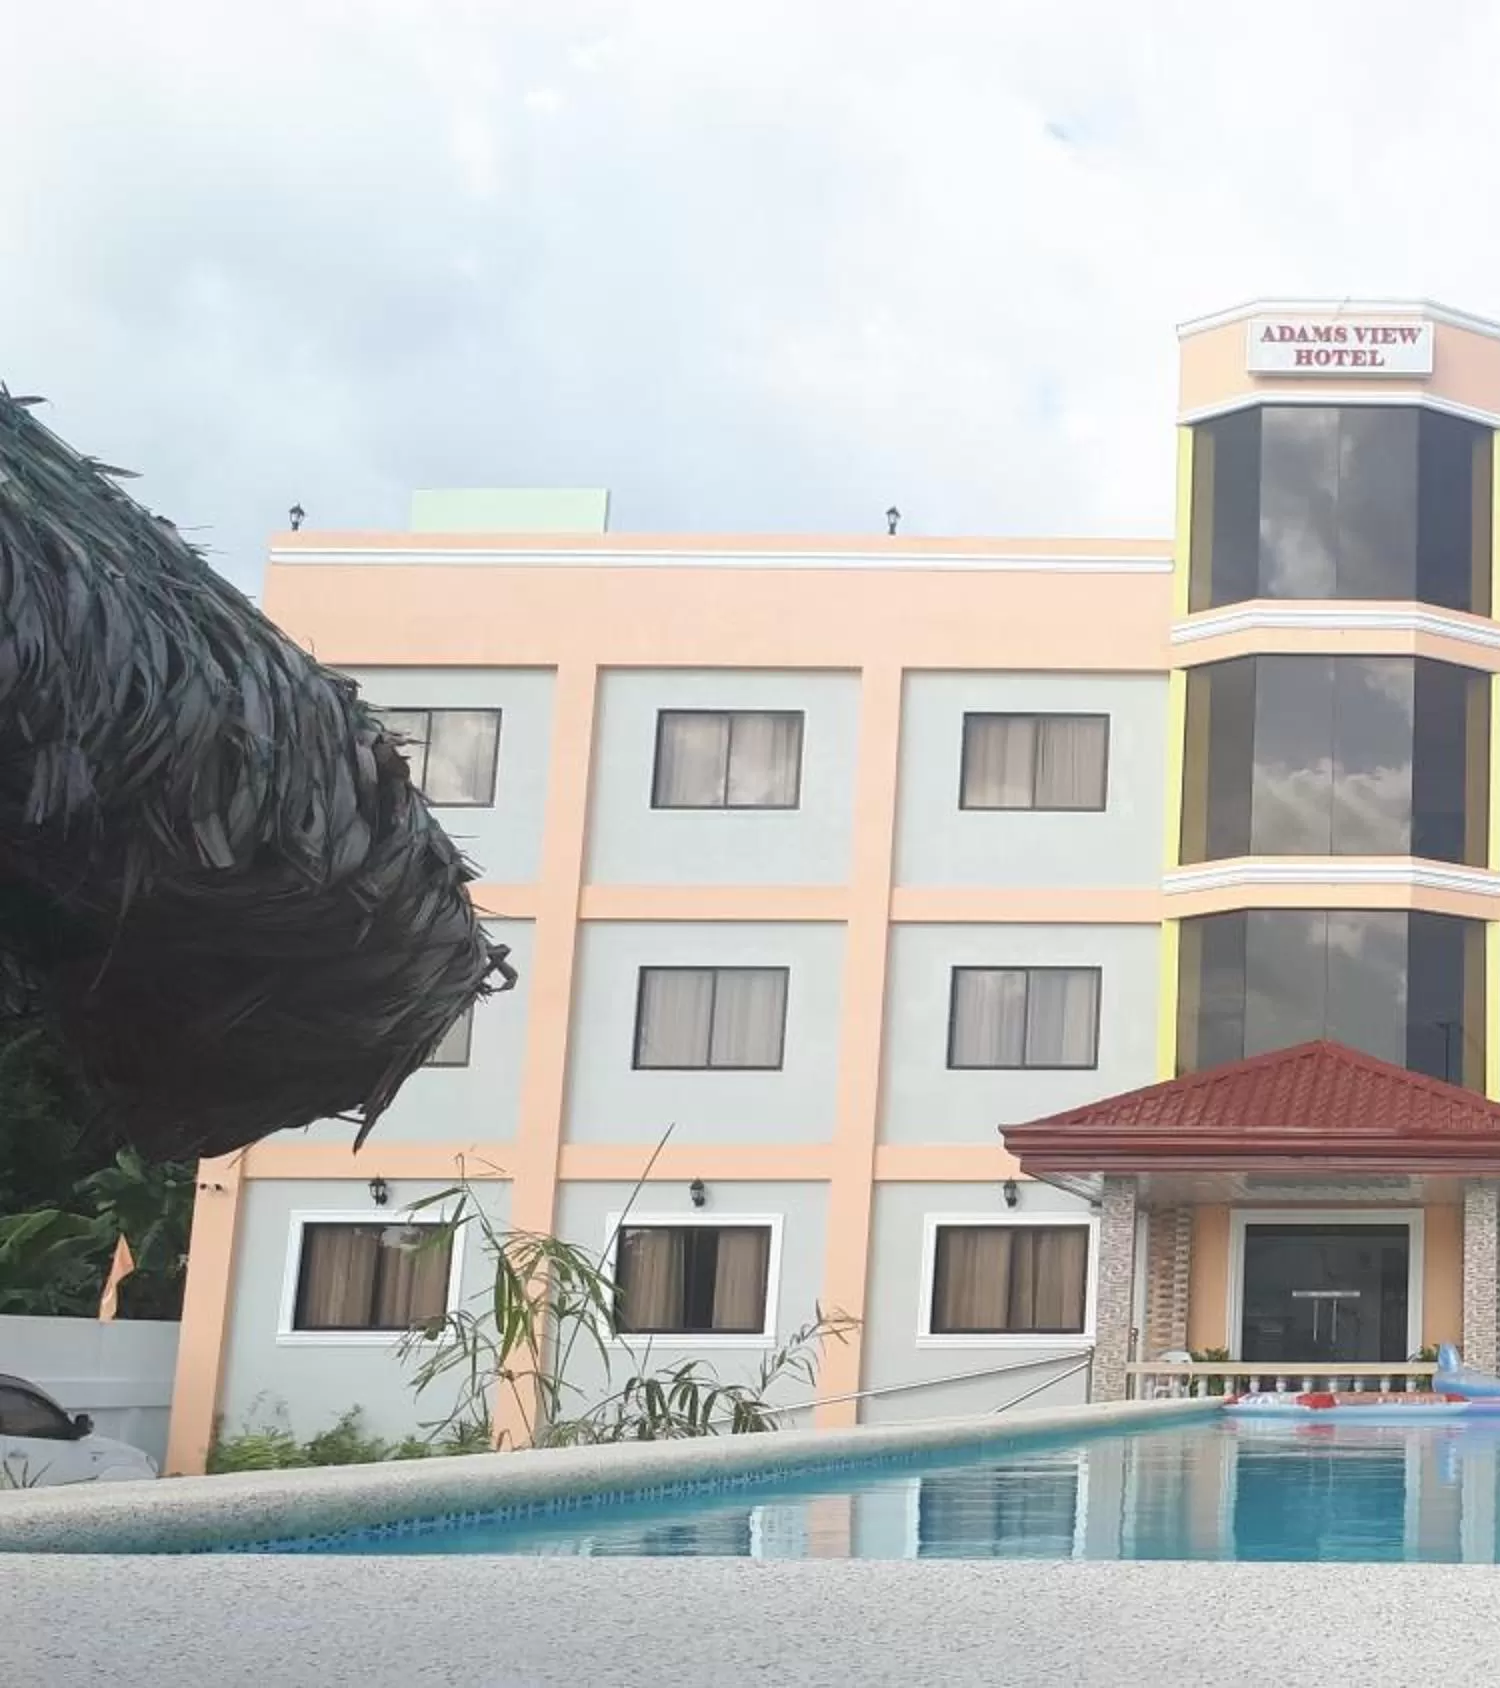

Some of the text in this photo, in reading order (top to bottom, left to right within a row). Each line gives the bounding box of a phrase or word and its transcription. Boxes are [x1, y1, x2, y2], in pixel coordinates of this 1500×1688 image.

[1261, 325, 1422, 345] ADAMS VIEW
[1295, 350, 1385, 367] HOTEL
